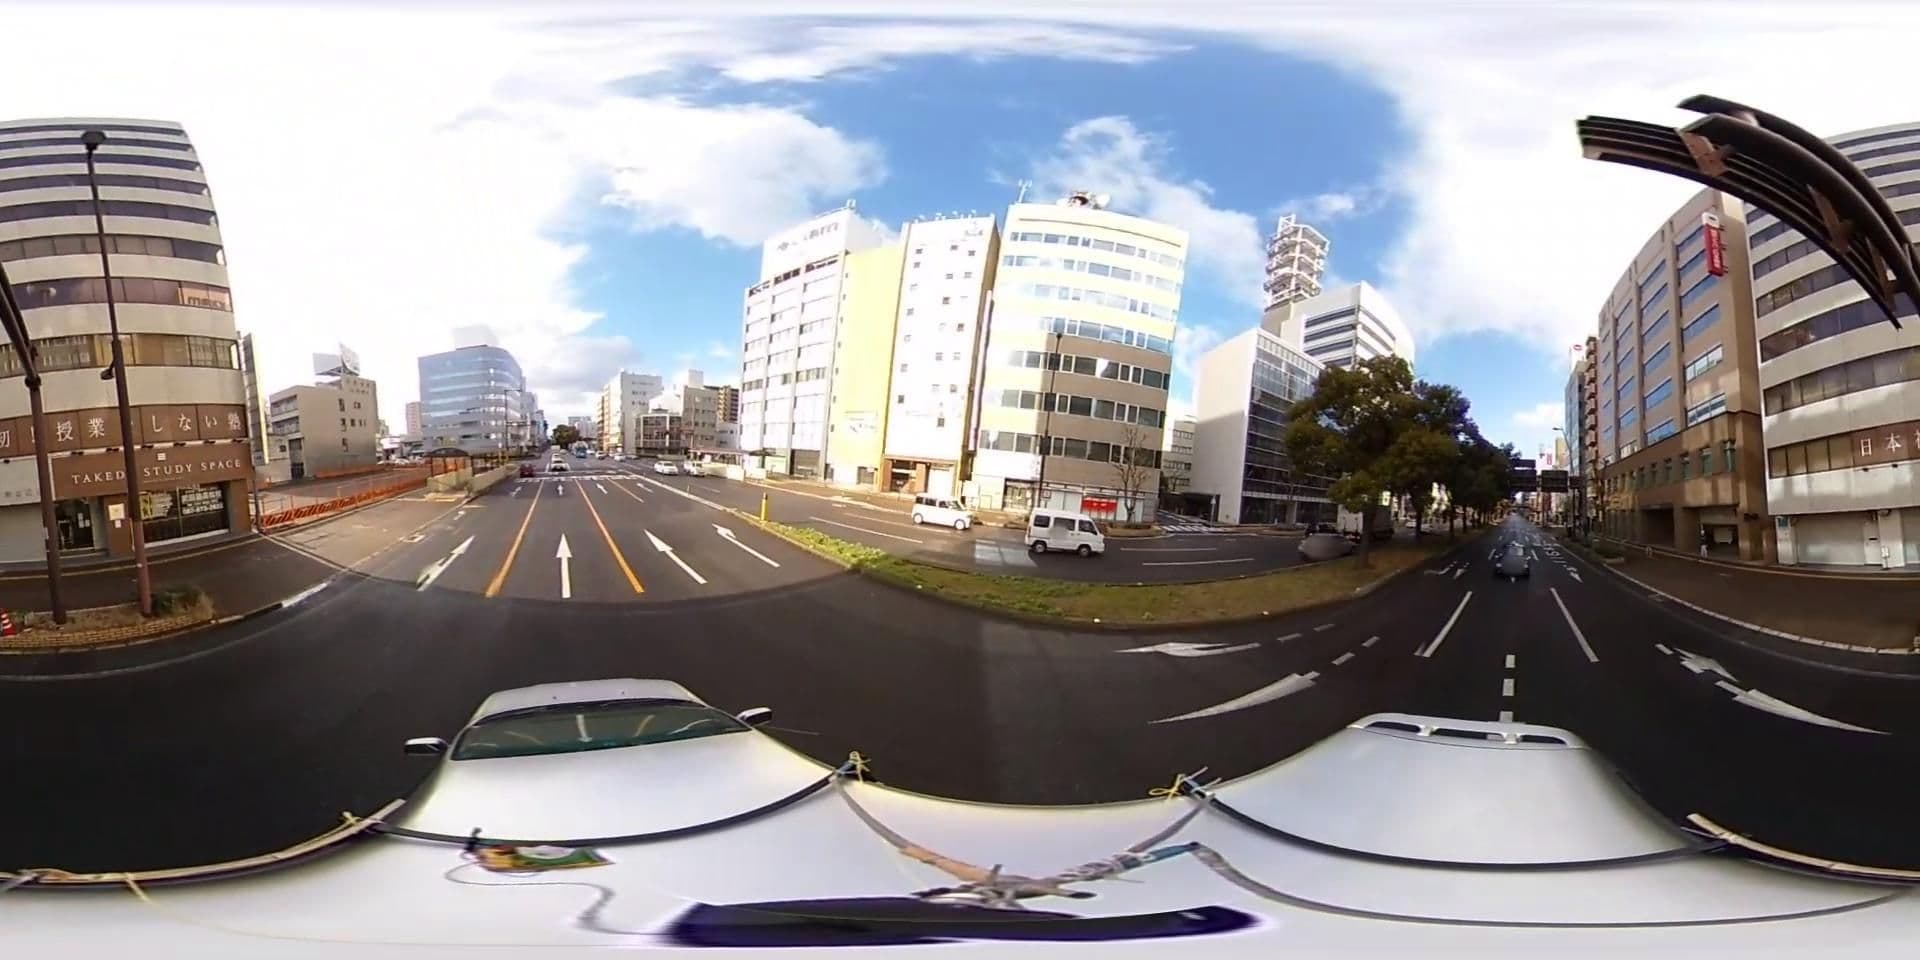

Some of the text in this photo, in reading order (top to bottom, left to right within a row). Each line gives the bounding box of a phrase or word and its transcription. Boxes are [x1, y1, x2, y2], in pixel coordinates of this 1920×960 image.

[72, 459, 241, 485] TAKED STUDY SPACE
